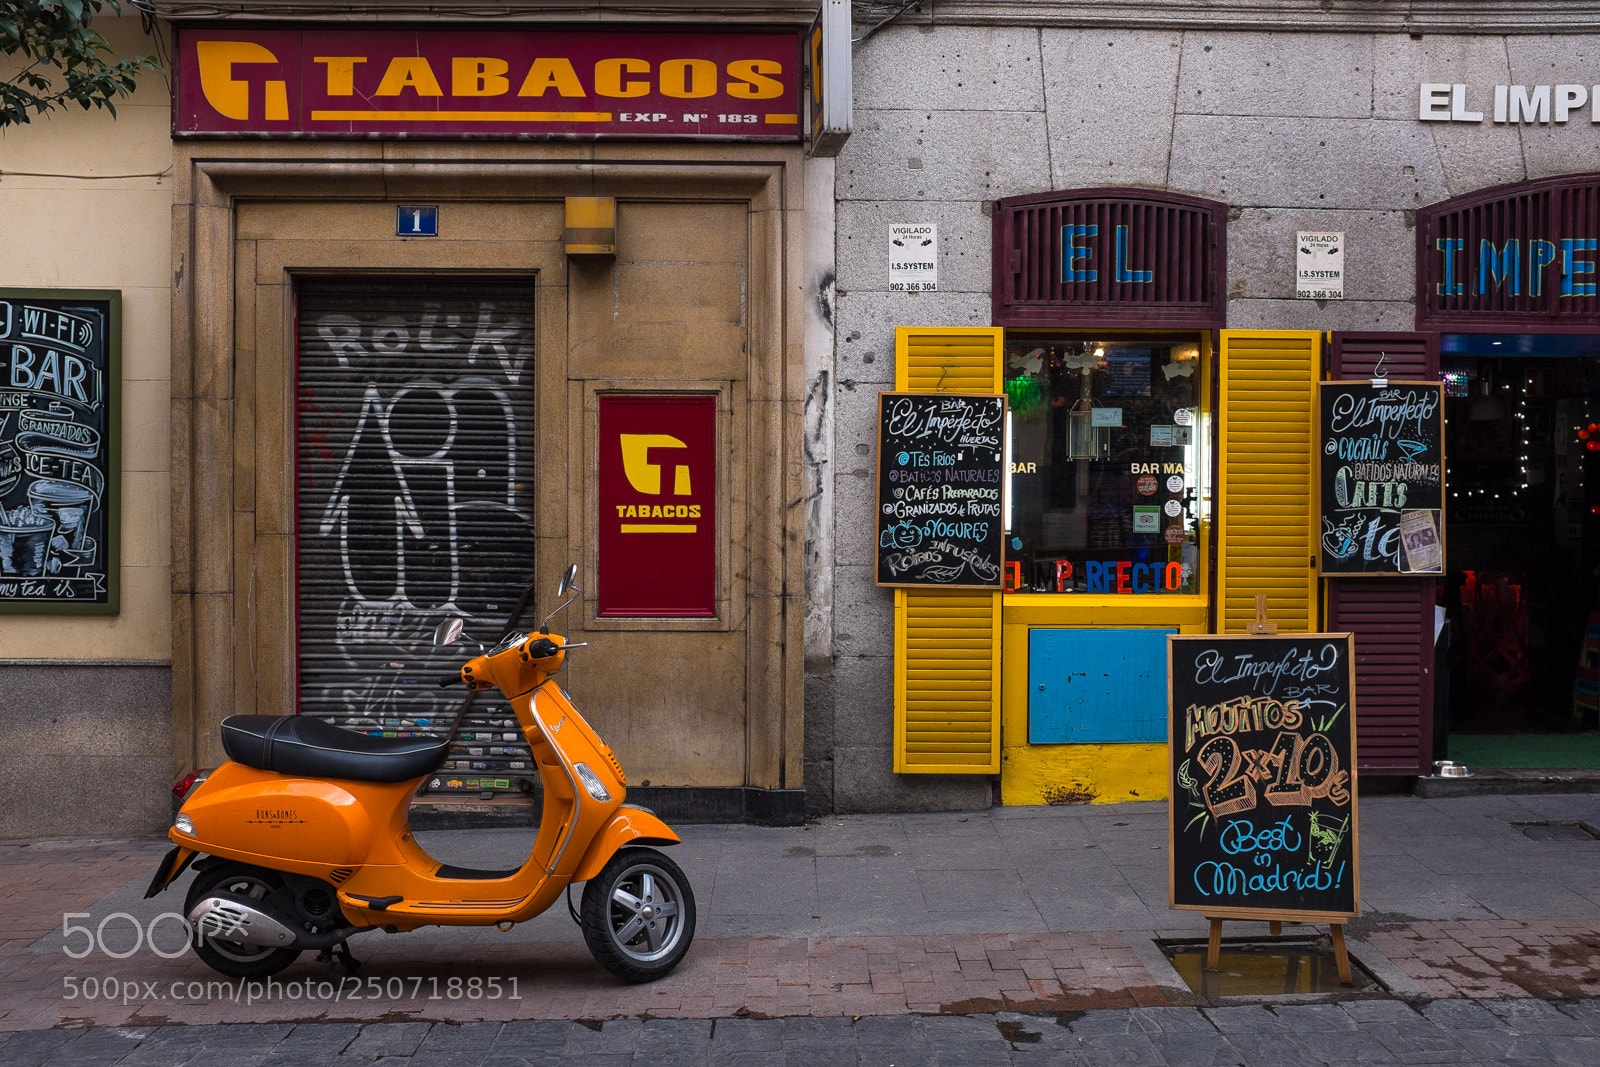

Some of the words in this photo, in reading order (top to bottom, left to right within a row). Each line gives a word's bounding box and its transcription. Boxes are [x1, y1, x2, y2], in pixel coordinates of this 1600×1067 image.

[313, 56, 784, 99] TABACOS
[1419, 83, 1484, 122] EL
[619, 112, 674, 123] EXP.
[717, 113, 758, 124] 183
[412, 209, 422, 232] 1
[1300, 235, 1339, 243] VIGILADO
[1060, 223, 1153, 284] EL
[891, 262, 934, 270] I.S.SYSTEM
[1299, 270, 1340, 278] I.S.SYSTEM
[1436, 237, 1598, 298] IMPE
[889, 282, 904, 291] 902
[906, 282, 920, 291] 366
[922, 282, 936, 291] 304
[1297, 290, 1311, 299] 902
[1312, 290, 1327, 299] 366
[1328, 290, 1342, 299] 304
[24, 308, 75, 343] WI-FI
[1380, 389, 1407, 400] BAR
[889, 398, 923, 436] El
[916, 399, 1002, 442] Imperfecto
[1331, 393, 1367, 433] El
[1361, 390, 1439, 440] Imperfecto
[21, 417, 92, 444] GRANIZADOS
[1338, 434, 1389, 461] COCTAILS
[25, 453, 92, 487] ICE-TEA
[945, 467, 1000, 483] NATURALES
[1131, 462, 1160, 474] BAR
[1354, 462, 1392, 481] BATIDOS
[615, 504, 702, 518] TABACOS
[967, 499, 1001, 517] FRUTAS
[925, 517, 989, 543] YOGURES
[21, 580, 46, 597] tea
[53, 580, 75, 598] is
[1194, 649, 1225, 685] El
[1223, 644, 1338, 696] Imperfecto
[1282, 684, 1340, 698] BAR
[1184, 695, 1303, 754] MOJITOS
[1219, 814, 1302, 855] Best
[1253, 851, 1272, 868] in
[1193, 859, 1346, 896] Madrid!
